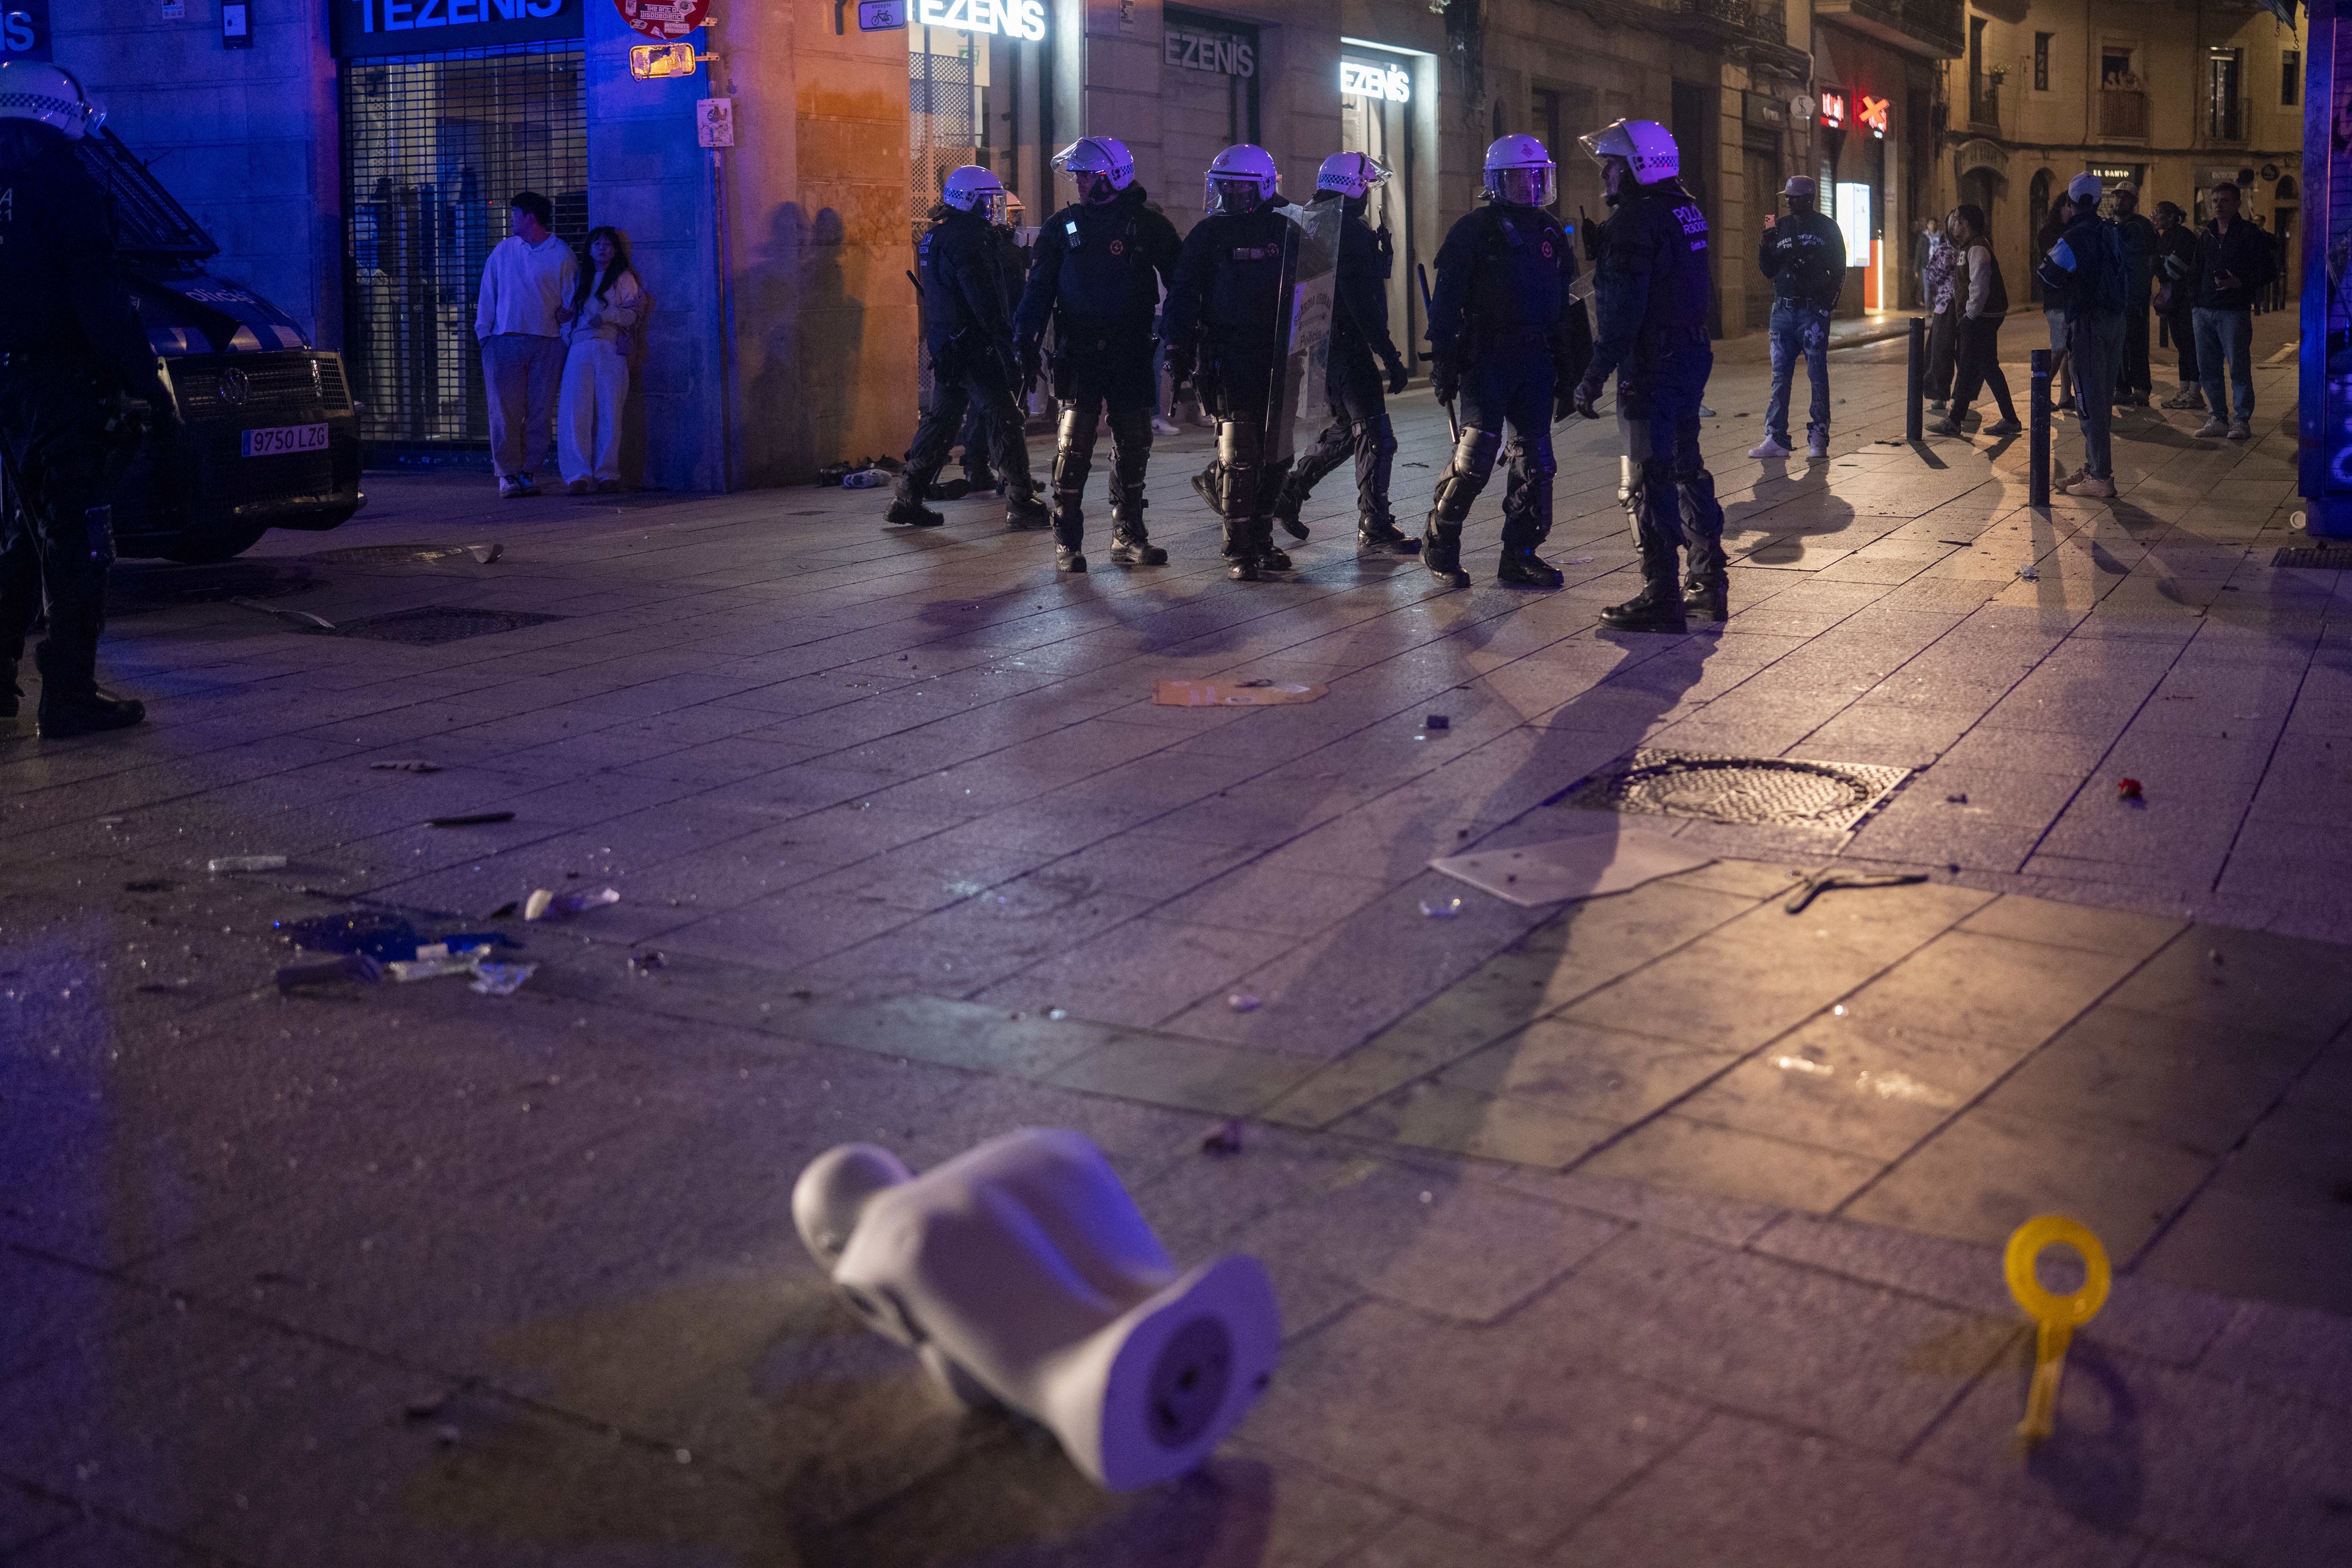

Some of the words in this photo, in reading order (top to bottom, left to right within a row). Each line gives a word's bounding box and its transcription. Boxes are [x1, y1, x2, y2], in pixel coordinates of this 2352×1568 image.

[353, 0, 561, 32] TEZENIS
[1165, 30, 1254, 77] EZENIS
[1341, 62, 1410, 103] EZENIS
[186, 288, 256, 304] olicia
[254, 430, 294, 452] 9750
[299, 427, 325, 448] LZG
